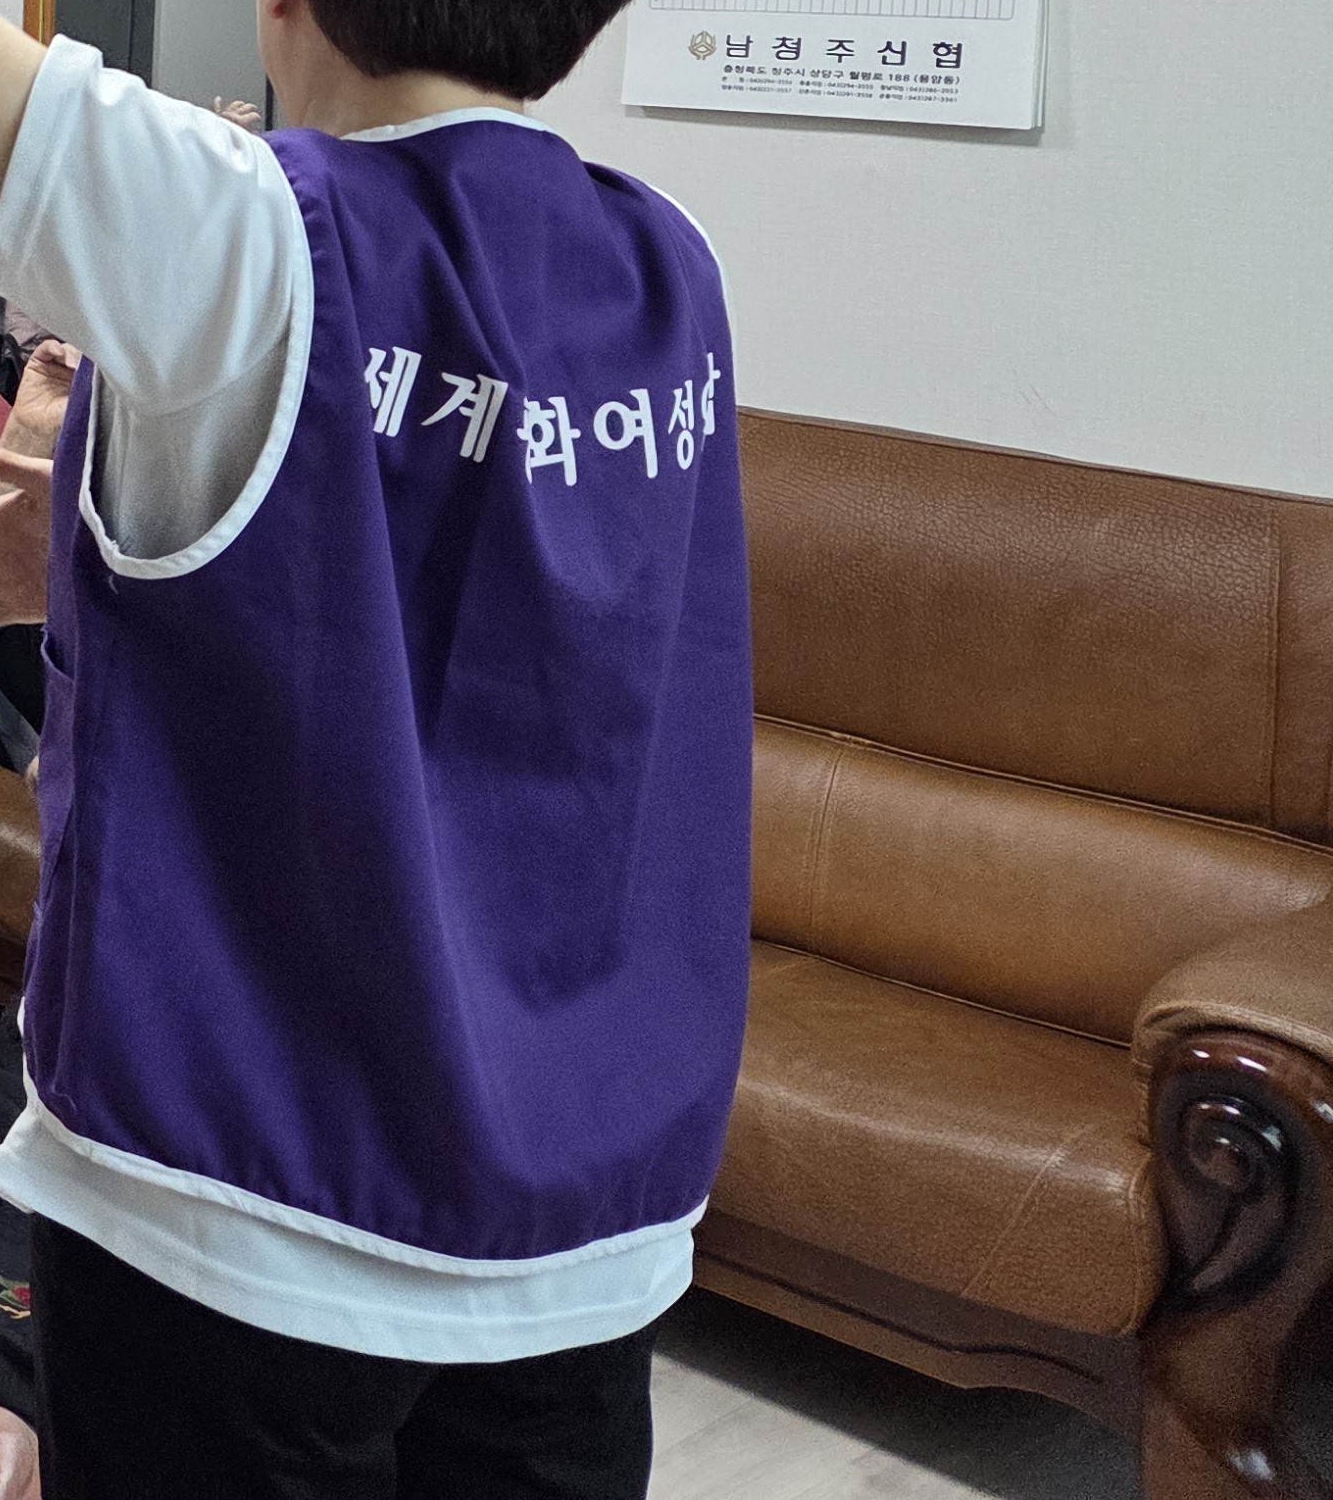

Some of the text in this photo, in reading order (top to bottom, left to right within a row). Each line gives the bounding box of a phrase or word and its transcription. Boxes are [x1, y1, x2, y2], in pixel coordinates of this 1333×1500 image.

[772, 67, 805, 76] 청주시
[810, 69, 844, 79] 상당구
[889, 74, 910, 82] 188
